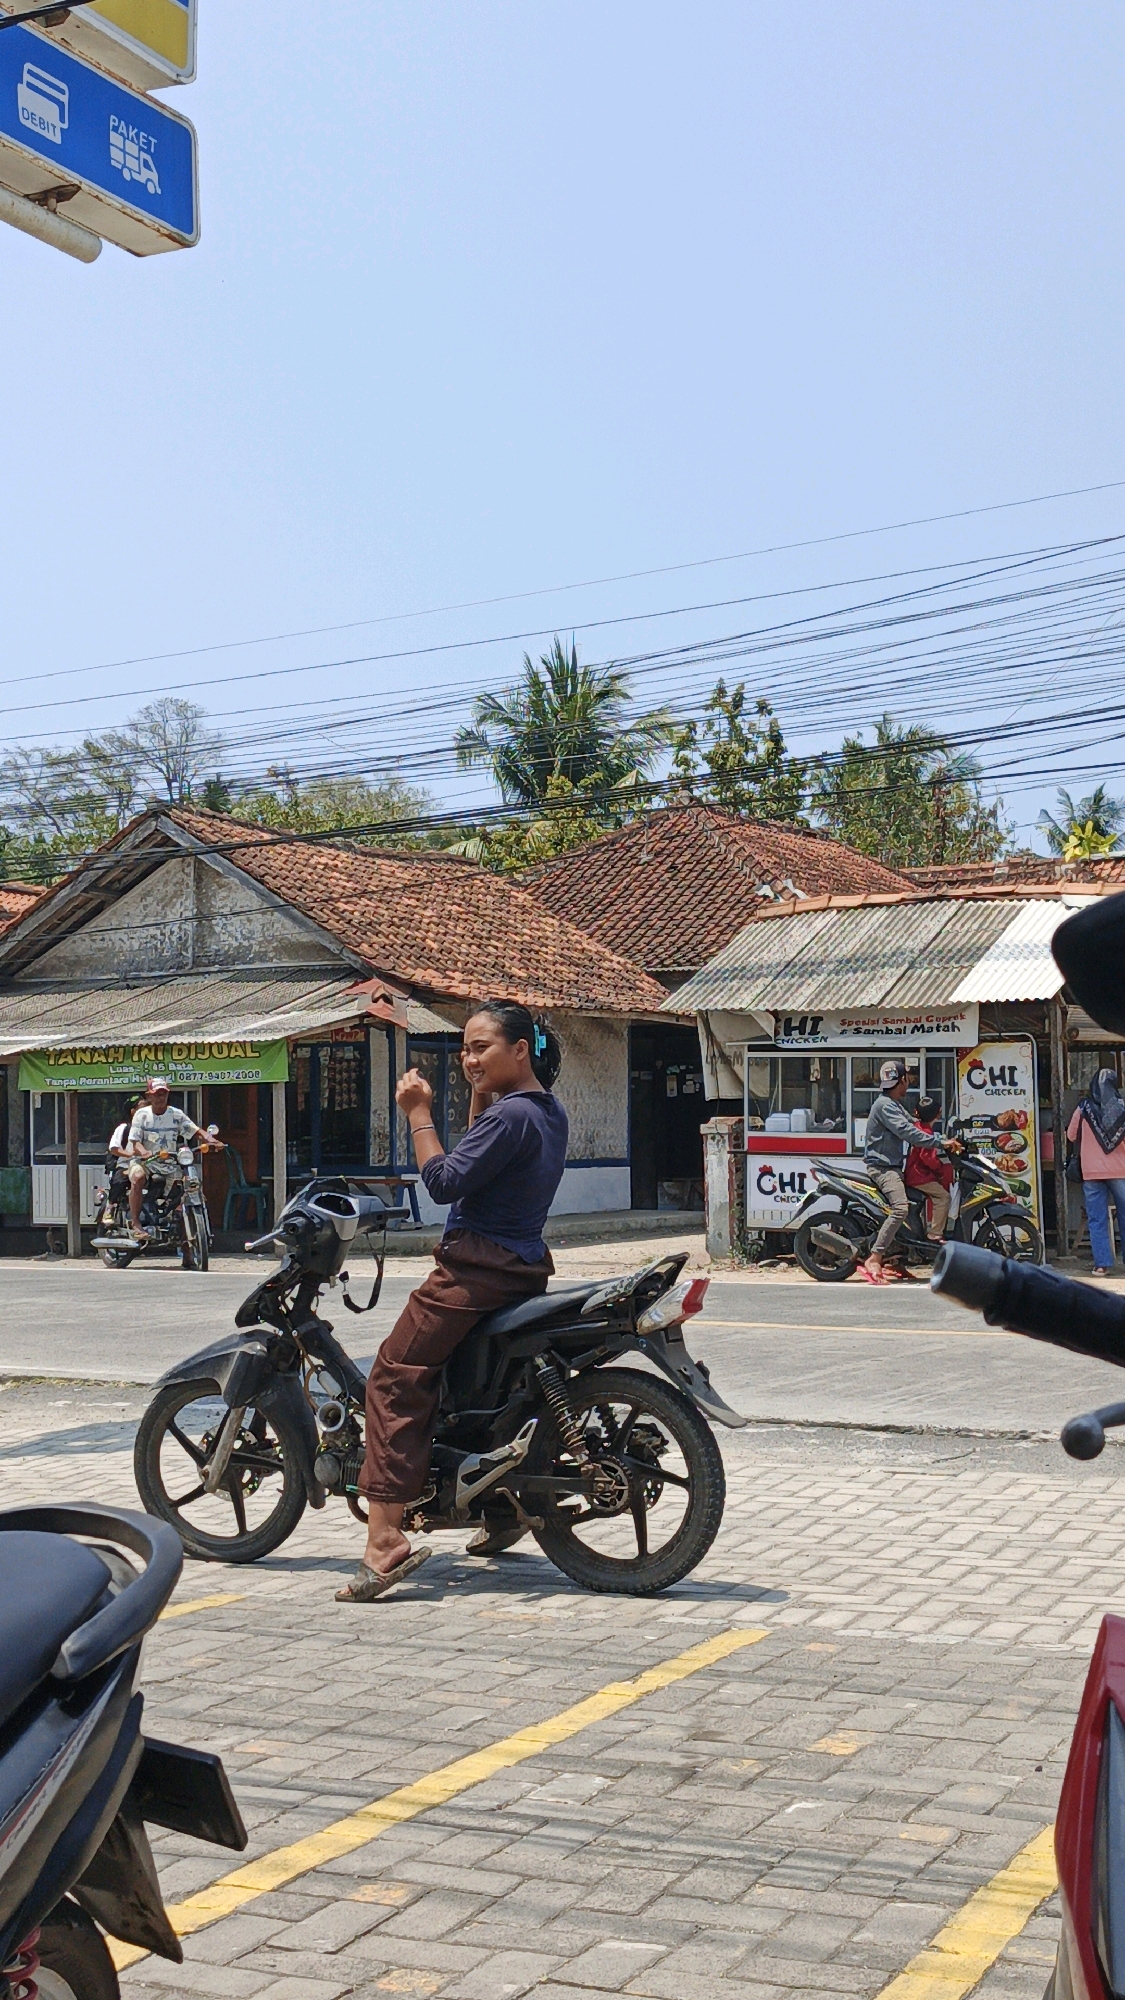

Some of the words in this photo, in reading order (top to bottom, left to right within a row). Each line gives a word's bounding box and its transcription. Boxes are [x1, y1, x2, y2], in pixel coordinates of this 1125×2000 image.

[21, 107, 57, 137] DEBIT
[109, 114, 158, 153] PAKET
[852, 1024, 907, 1035] Sambal
[910, 1021, 961, 1035] Matah
[882, 1016, 922, 1025] Sambal
[46, 1046, 125, 1066] TANAH
[131, 1044, 167, 1063] INI
[171, 1041, 261, 1061] DIJUAL
[44, 1078, 77, 1088] Tanpa
[966, 1064, 1019, 1090] CHI
[984, 1087, 1027, 1096] CHICKEN
[756, 1170, 807, 1195] CHI
